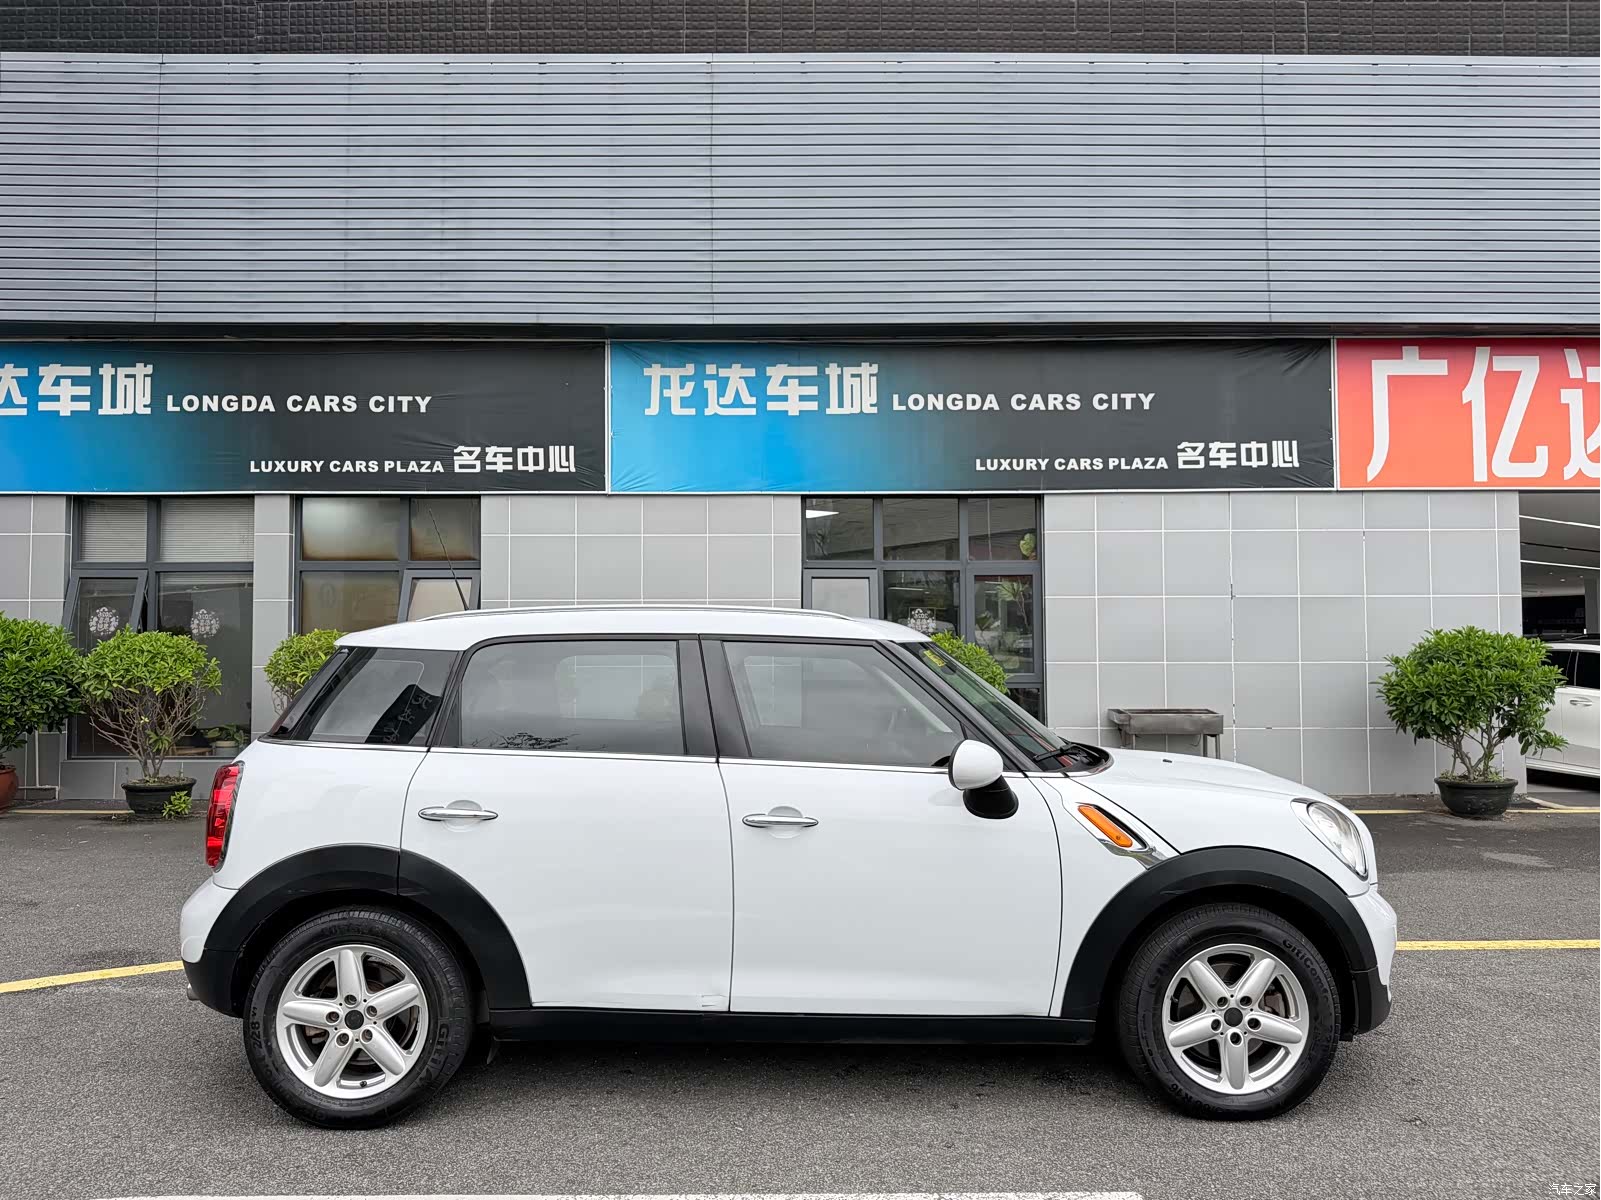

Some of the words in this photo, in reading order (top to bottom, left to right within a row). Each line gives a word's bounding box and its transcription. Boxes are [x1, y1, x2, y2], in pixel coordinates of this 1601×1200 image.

[643, 362, 879, 416] 龙达车城
[166, 394, 276, 413] LONGDA
[286, 394, 358, 413] CARS
[368, 395, 432, 413] CITY
[892, 393, 1000, 411] LONGDA
[1010, 393, 1082, 411] CARS
[1092, 392, 1156, 411] CITY
[453, 445, 577, 473] 名车中心
[975, 458, 1050, 471] LUXURY
[1053, 457, 1104, 471] CARS
[1108, 456, 1169, 470] PLAZA
[1176, 439, 1300, 470] 名车中心
[250, 460, 325, 473] LUXURY
[329, 460, 379, 473] CARS
[384, 460, 445, 473] PLAZA
